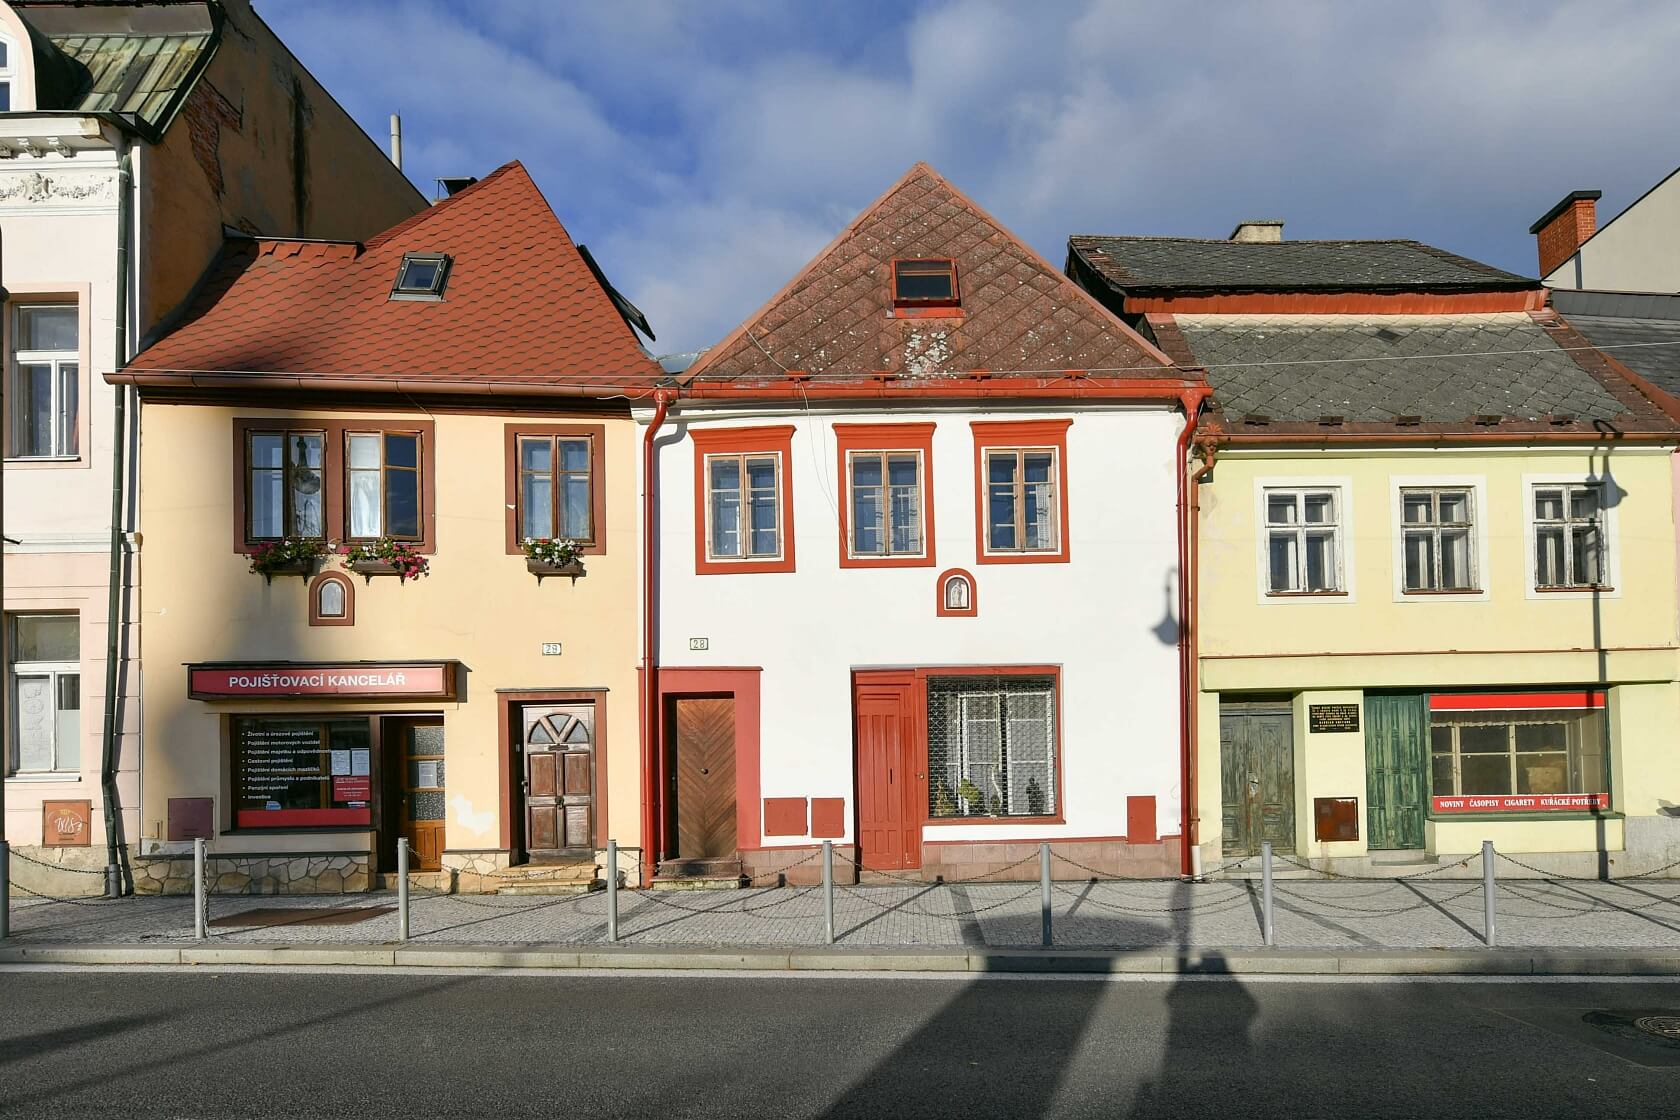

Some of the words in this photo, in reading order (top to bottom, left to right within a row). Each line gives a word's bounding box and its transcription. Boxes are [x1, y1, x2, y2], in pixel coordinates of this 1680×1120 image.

[693, 639, 705, 649] 28
[229, 674, 324, 688] POJIŠŤOVACÍ
[328, 672, 405, 687] KANCELÁŘ
[1439, 800, 1464, 808] NOVINY
[1469, 798, 1500, 807] ČASOPISY
[1504, 799, 1536, 807] CIGARETY
[1540, 797, 1570, 806] KUŘÁCKÉ
